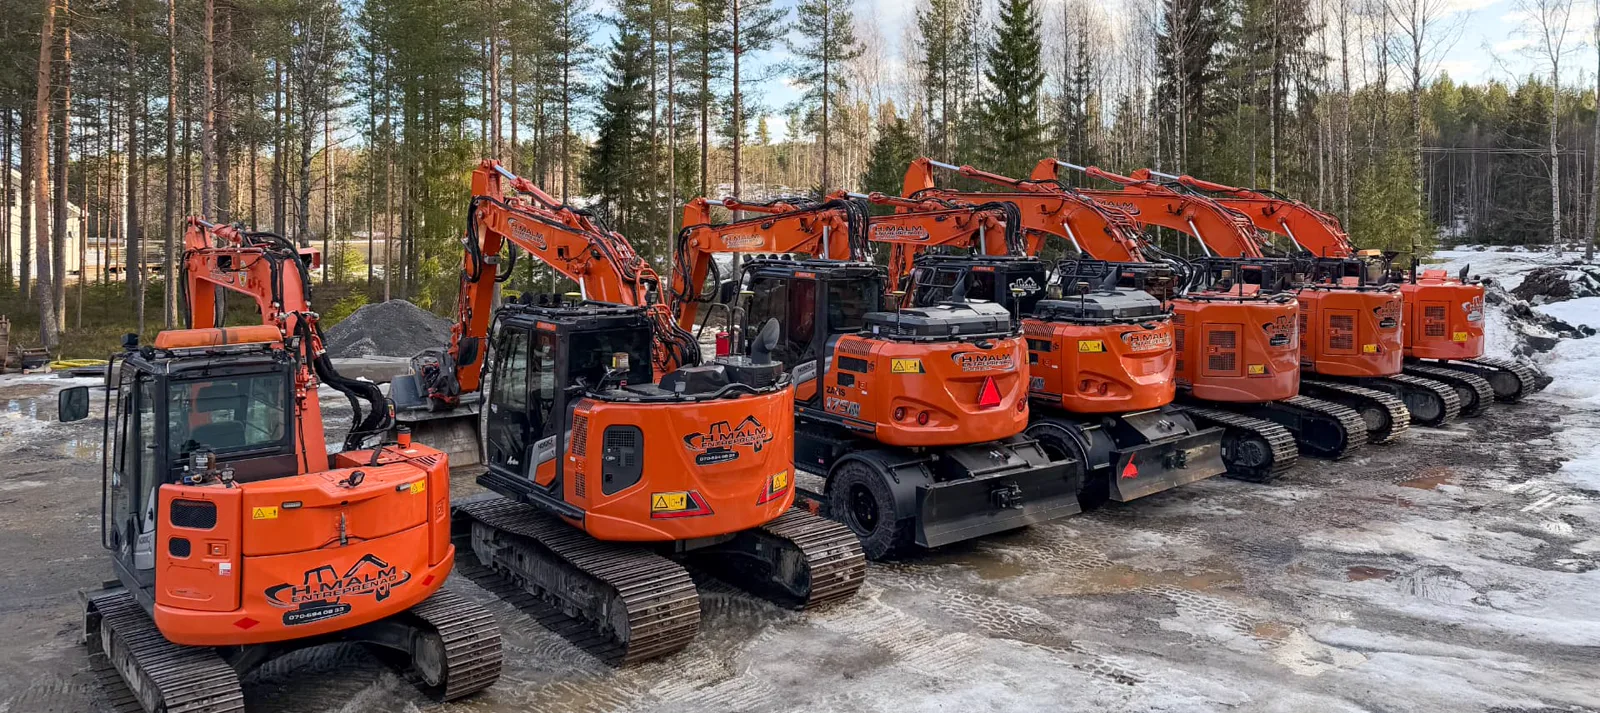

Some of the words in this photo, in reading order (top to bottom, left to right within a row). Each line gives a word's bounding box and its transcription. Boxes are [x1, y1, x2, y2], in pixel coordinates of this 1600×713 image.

[962, 353, 1012, 363] H.MALM
[701, 426, 766, 443] H.MALM
[291, 565, 397, 597] H.MALM
[291, 574, 397, 603] ENTREPRENAD
